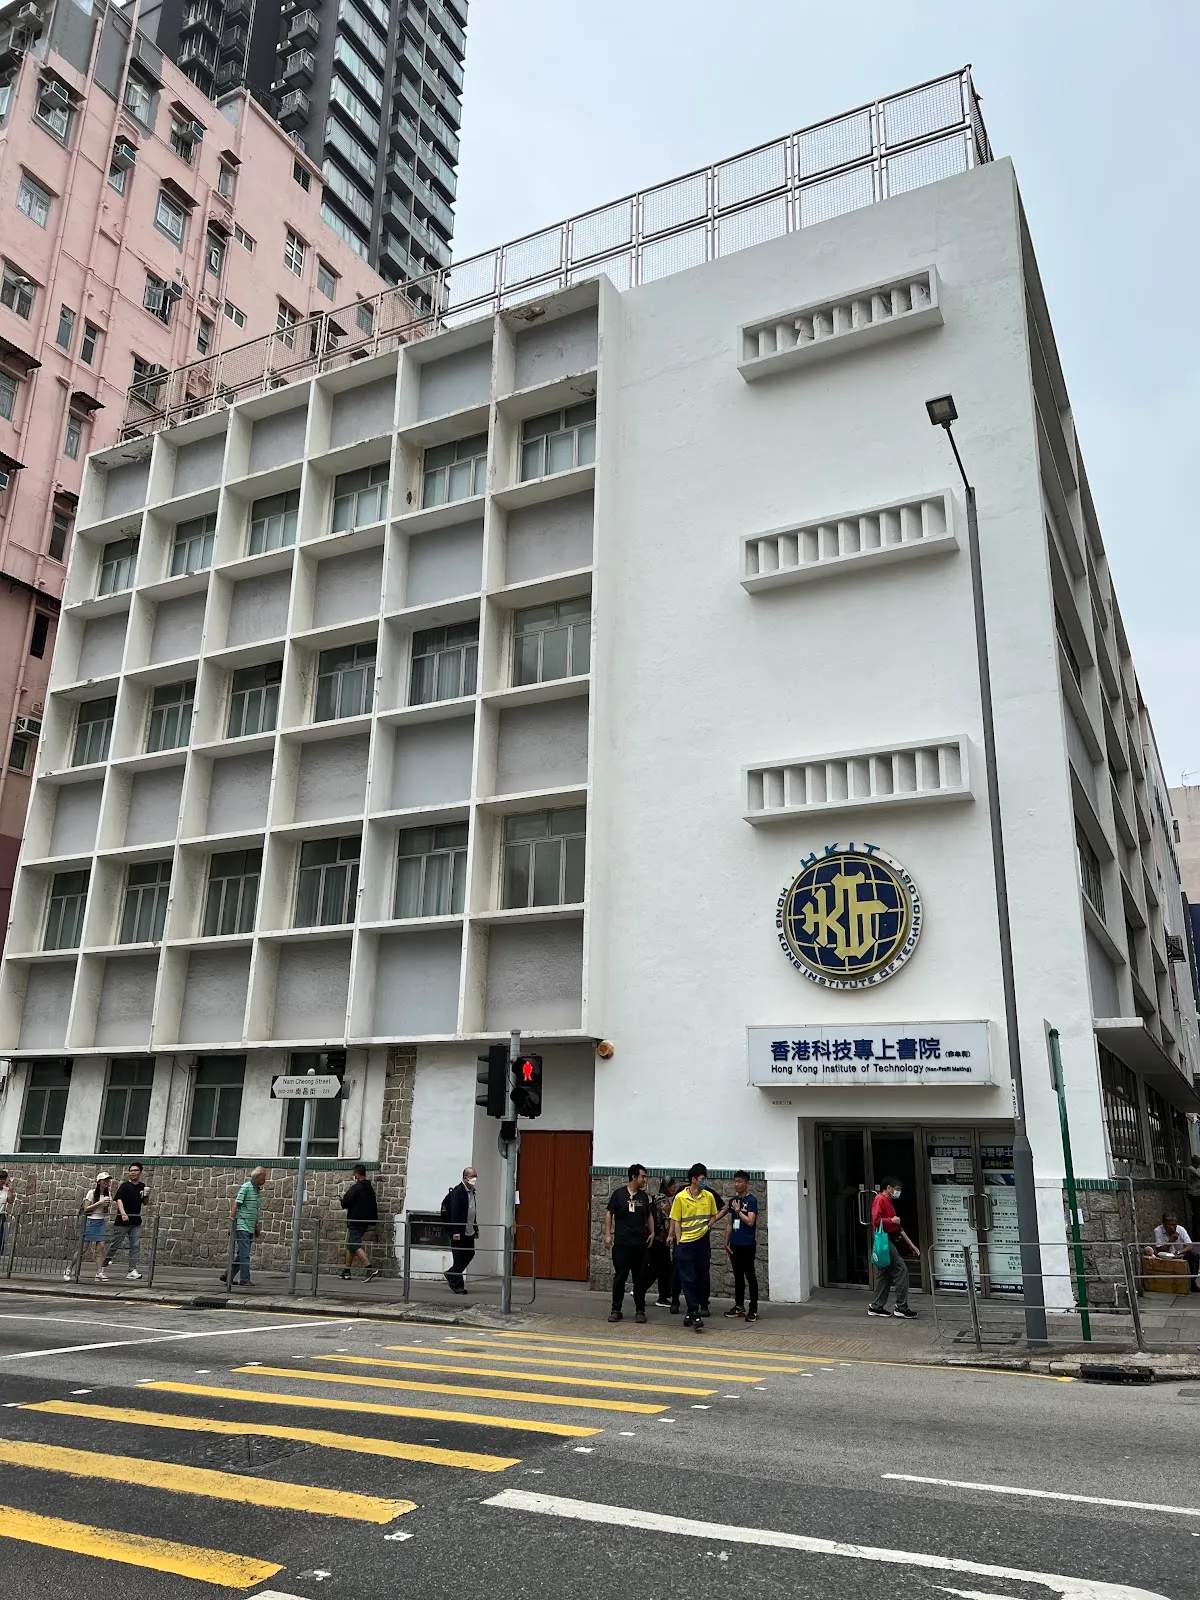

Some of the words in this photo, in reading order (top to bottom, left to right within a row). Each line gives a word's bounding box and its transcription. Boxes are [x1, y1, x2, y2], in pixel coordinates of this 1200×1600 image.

[800, 842, 880, 869] HKIT
[775, 887, 788, 928] HONG
[895, 868, 921, 965] TECHNOLOGY
[777, 932, 802, 969] KONG
[803, 968, 876, 989] INSTITUTE
[879, 963, 895, 978] OF
[770, 1037, 941, 1062] 香港科技專上書院
[771, 1064, 793, 1075] Hong
[797, 1064, 818, 1074] Kong
[822, 1064, 857, 1073] Institute
[861, 1064, 870, 1073] of
[874, 1063, 924, 1074] Technology
[295, 1078, 314, 1086] Cheong
